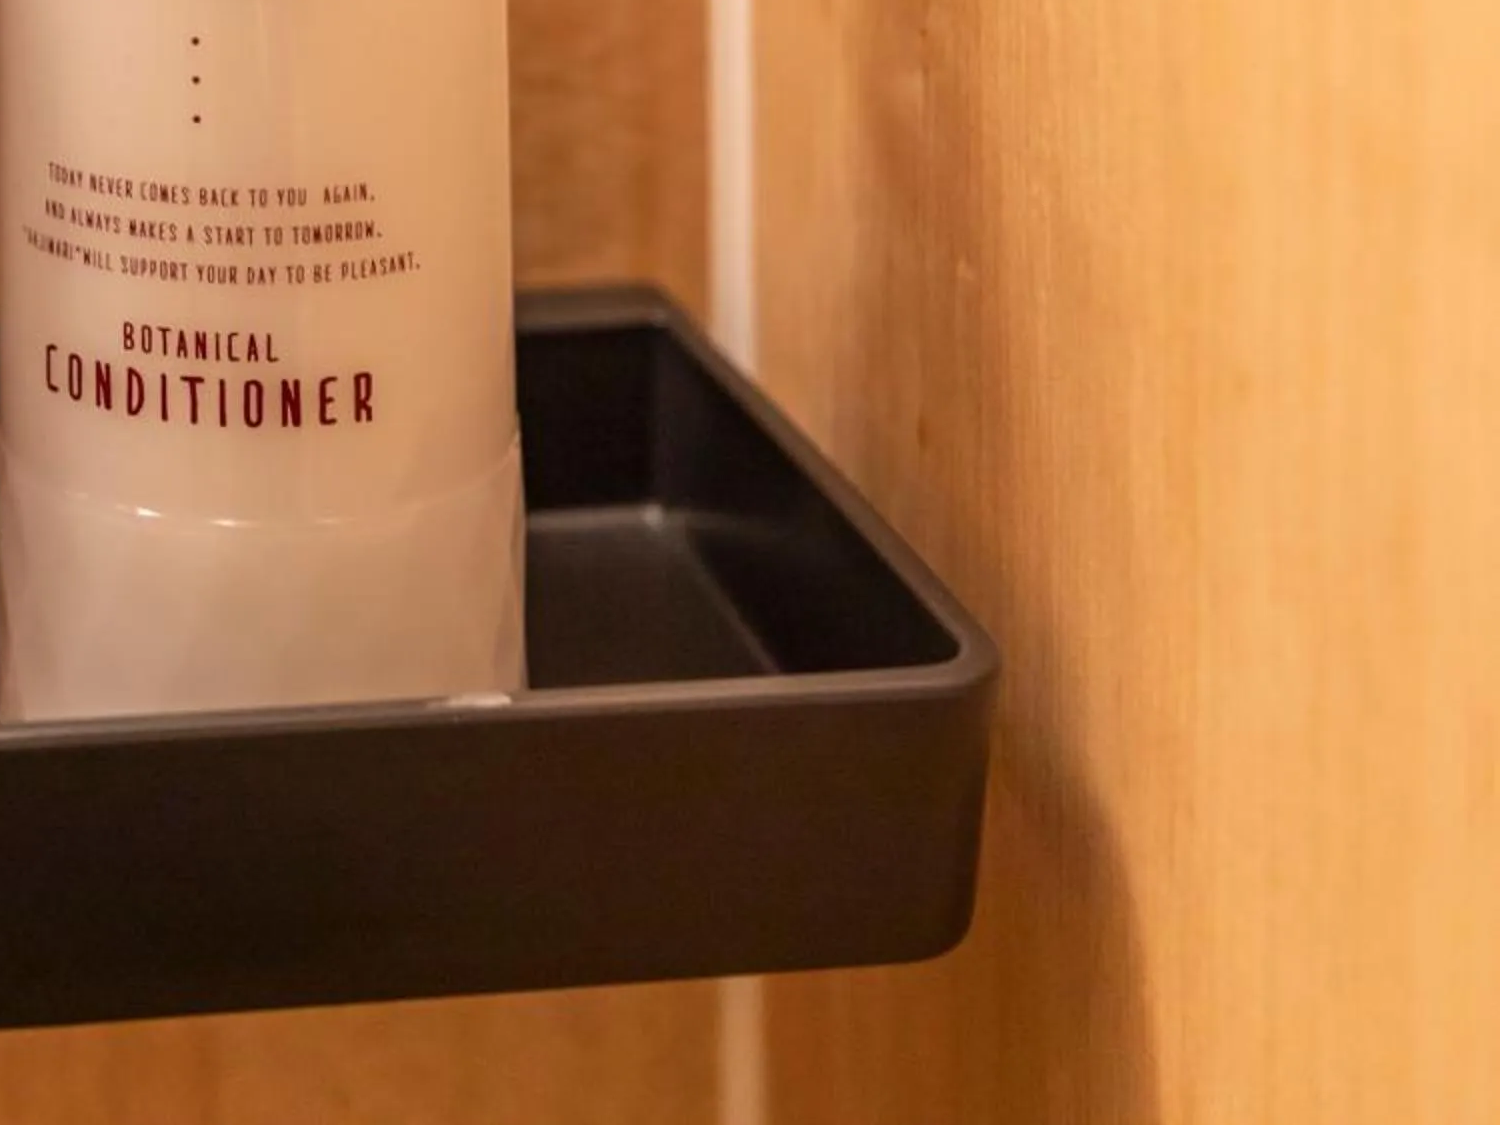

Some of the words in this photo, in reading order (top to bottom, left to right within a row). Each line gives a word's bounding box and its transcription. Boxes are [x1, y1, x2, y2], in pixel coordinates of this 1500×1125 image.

[48, 162, 83, 188] TODAY
[90, 173, 133, 198] NEVER
[140, 181, 190, 205] COMES
[199, 186, 238, 208] BACK
[248, 188, 268, 208] TO
[277, 187, 307, 207] YOU
[323, 182, 375, 205] AGAIN.
[45, 198, 65, 220] AND
[70, 207, 120, 234] ALWAYS
[129, 219, 177, 242] MAKES
[187, 226, 195, 243] A
[203, 226, 254, 245] START
[264, 227, 283, 245] TO
[293, 220, 383, 245] TOMORROW.
[120, 255, 187, 281] SUPPORT
[196, 264, 237, 284] YOUR
[247, 265, 277, 285] DAY
[286, 265, 305, 284] TO
[314, 263, 332, 284] BE
[341, 251, 420, 282] PLEASANT.
[123, 322, 279, 363] BOTANICAL
[46, 343, 373, 428] CONDITIONER
